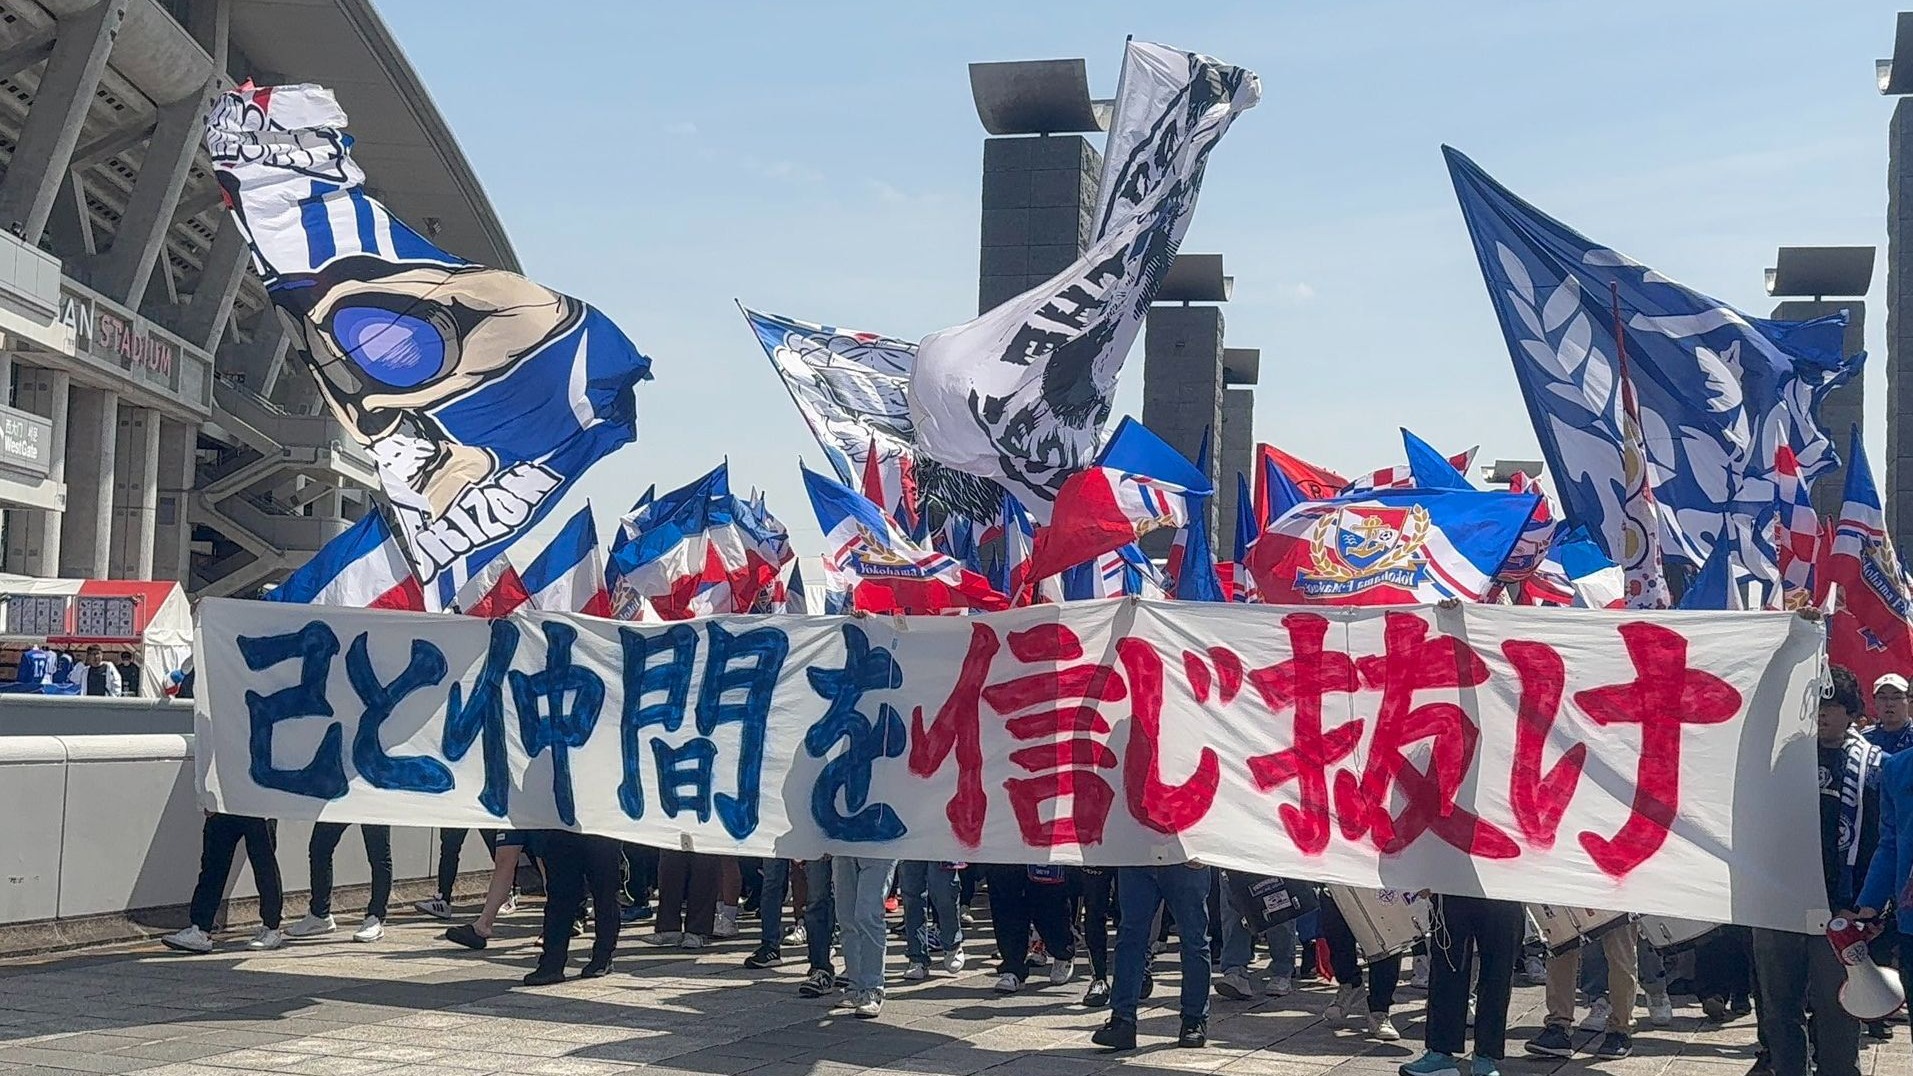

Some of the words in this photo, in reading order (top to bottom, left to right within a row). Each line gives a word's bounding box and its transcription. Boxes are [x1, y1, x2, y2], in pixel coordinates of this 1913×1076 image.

[100, 314, 172, 377] STADIUM
[859, 562, 917, 577] Yokohama
[236, 611, 1743, 879] 己と仲間を信じ抜け
